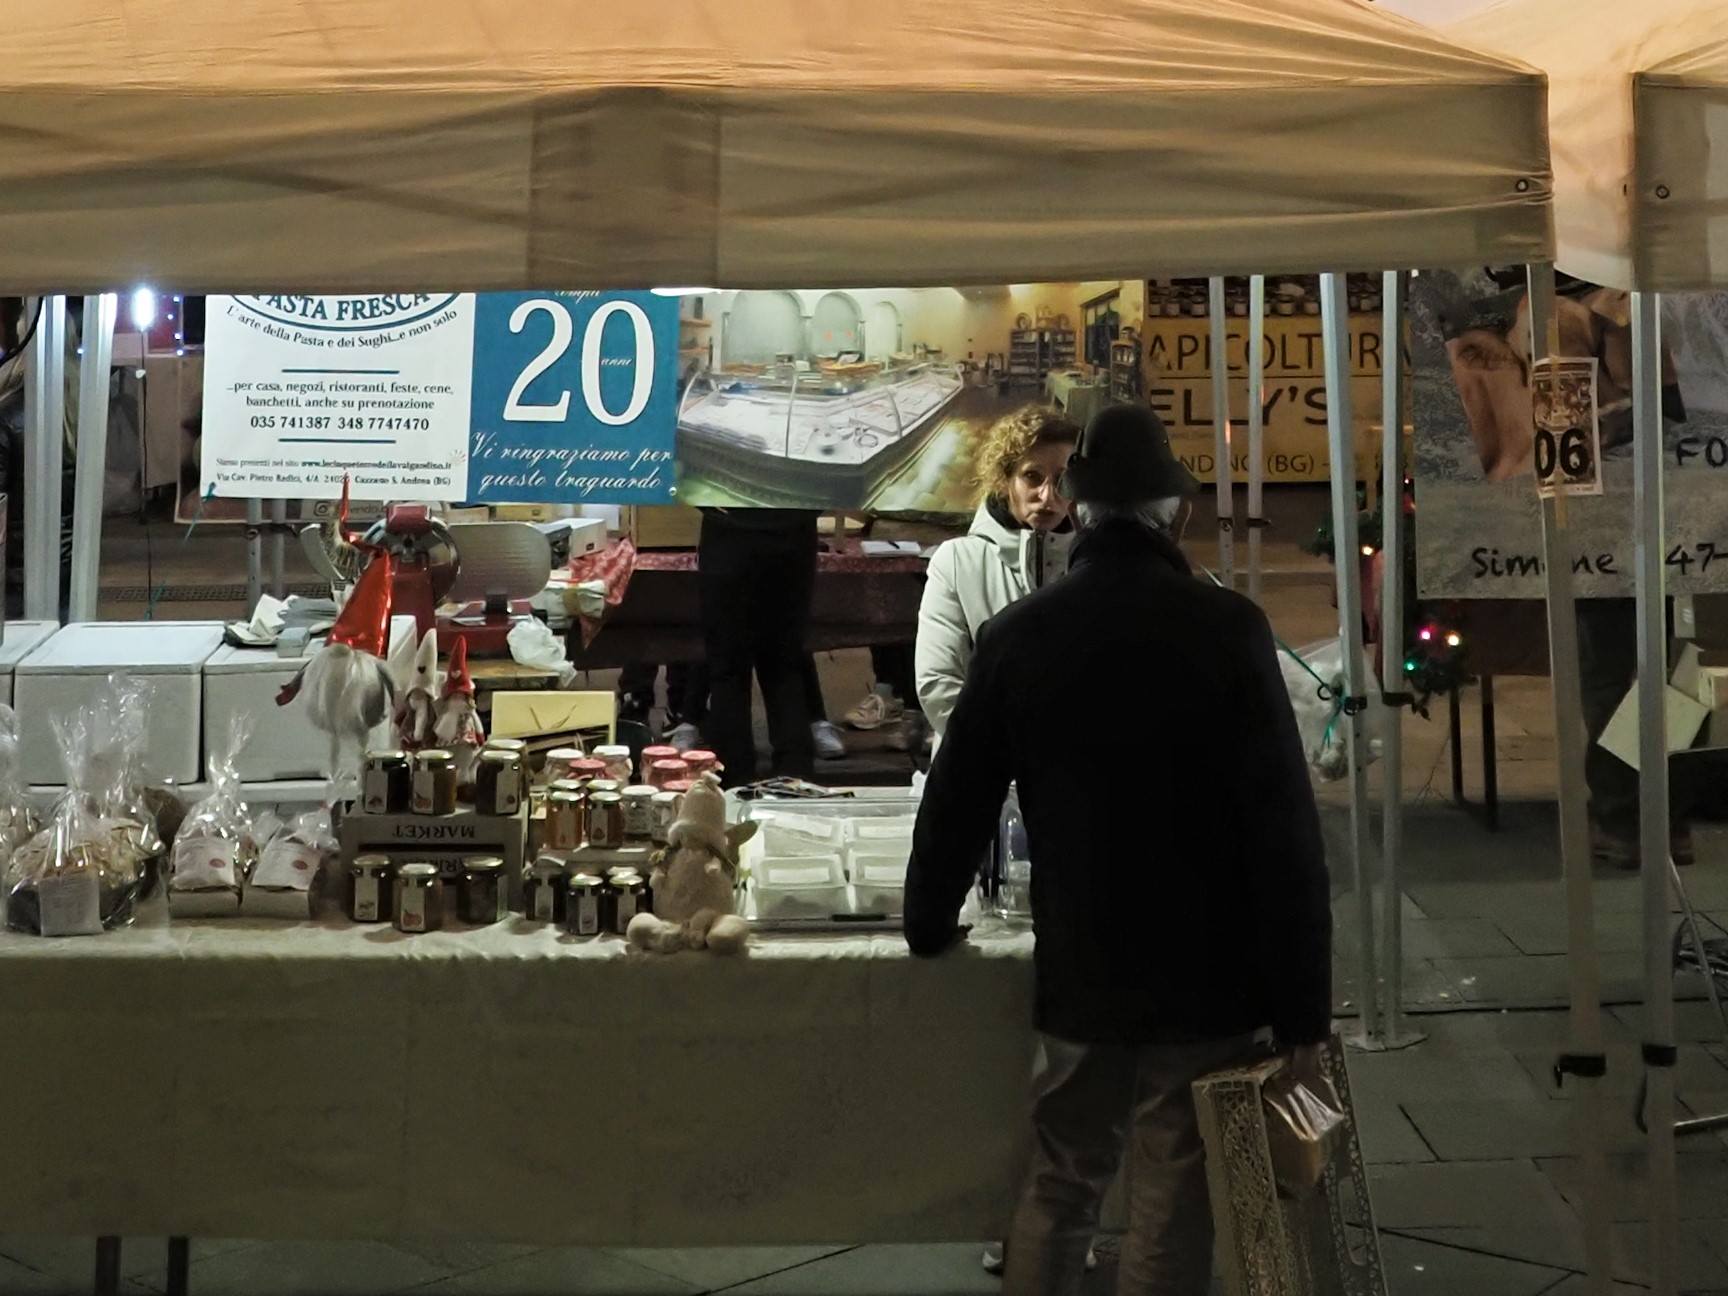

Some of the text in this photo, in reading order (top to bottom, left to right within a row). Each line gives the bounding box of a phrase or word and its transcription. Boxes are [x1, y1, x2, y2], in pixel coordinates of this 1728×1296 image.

[254, 293, 431, 322] ASTA FRESCA
[238, 315, 261, 330] arte
[263, 322, 290, 342] della
[293, 333, 324, 348] Pasta
[327, 339, 335, 348] e
[337, 336, 356, 348] dei
[408, 320, 433, 338] non
[433, 308, 458, 329] solo
[503, 298, 655, 426] 20
[601, 357, 633, 367] anni
[1150, 333, 1411, 371] APICOLTR
[256, 382, 283, 393] casa,
[286, 381, 326, 394] negozi,
[329, 381, 387, 394] ristoranti,
[390, 381, 421, 395] feste,
[424, 384, 454, 395] cene,
[305, 397, 338, 408] anche
[341, 399, 355, 408] su
[357, 398, 435, 411] prenotazione
[250, 416, 430, 431] 035 741387 348 7747470
[470, 431, 673, 471] Vi ringraziamo per
[1268, 454, 1314, 474] (BG)
[1535, 428, 1589, 477] 06
[478, 466, 663, 496] questo traguardo
[1471, 546, 1619, 580] Simne
[393, 824, 476, 839] MARKET
